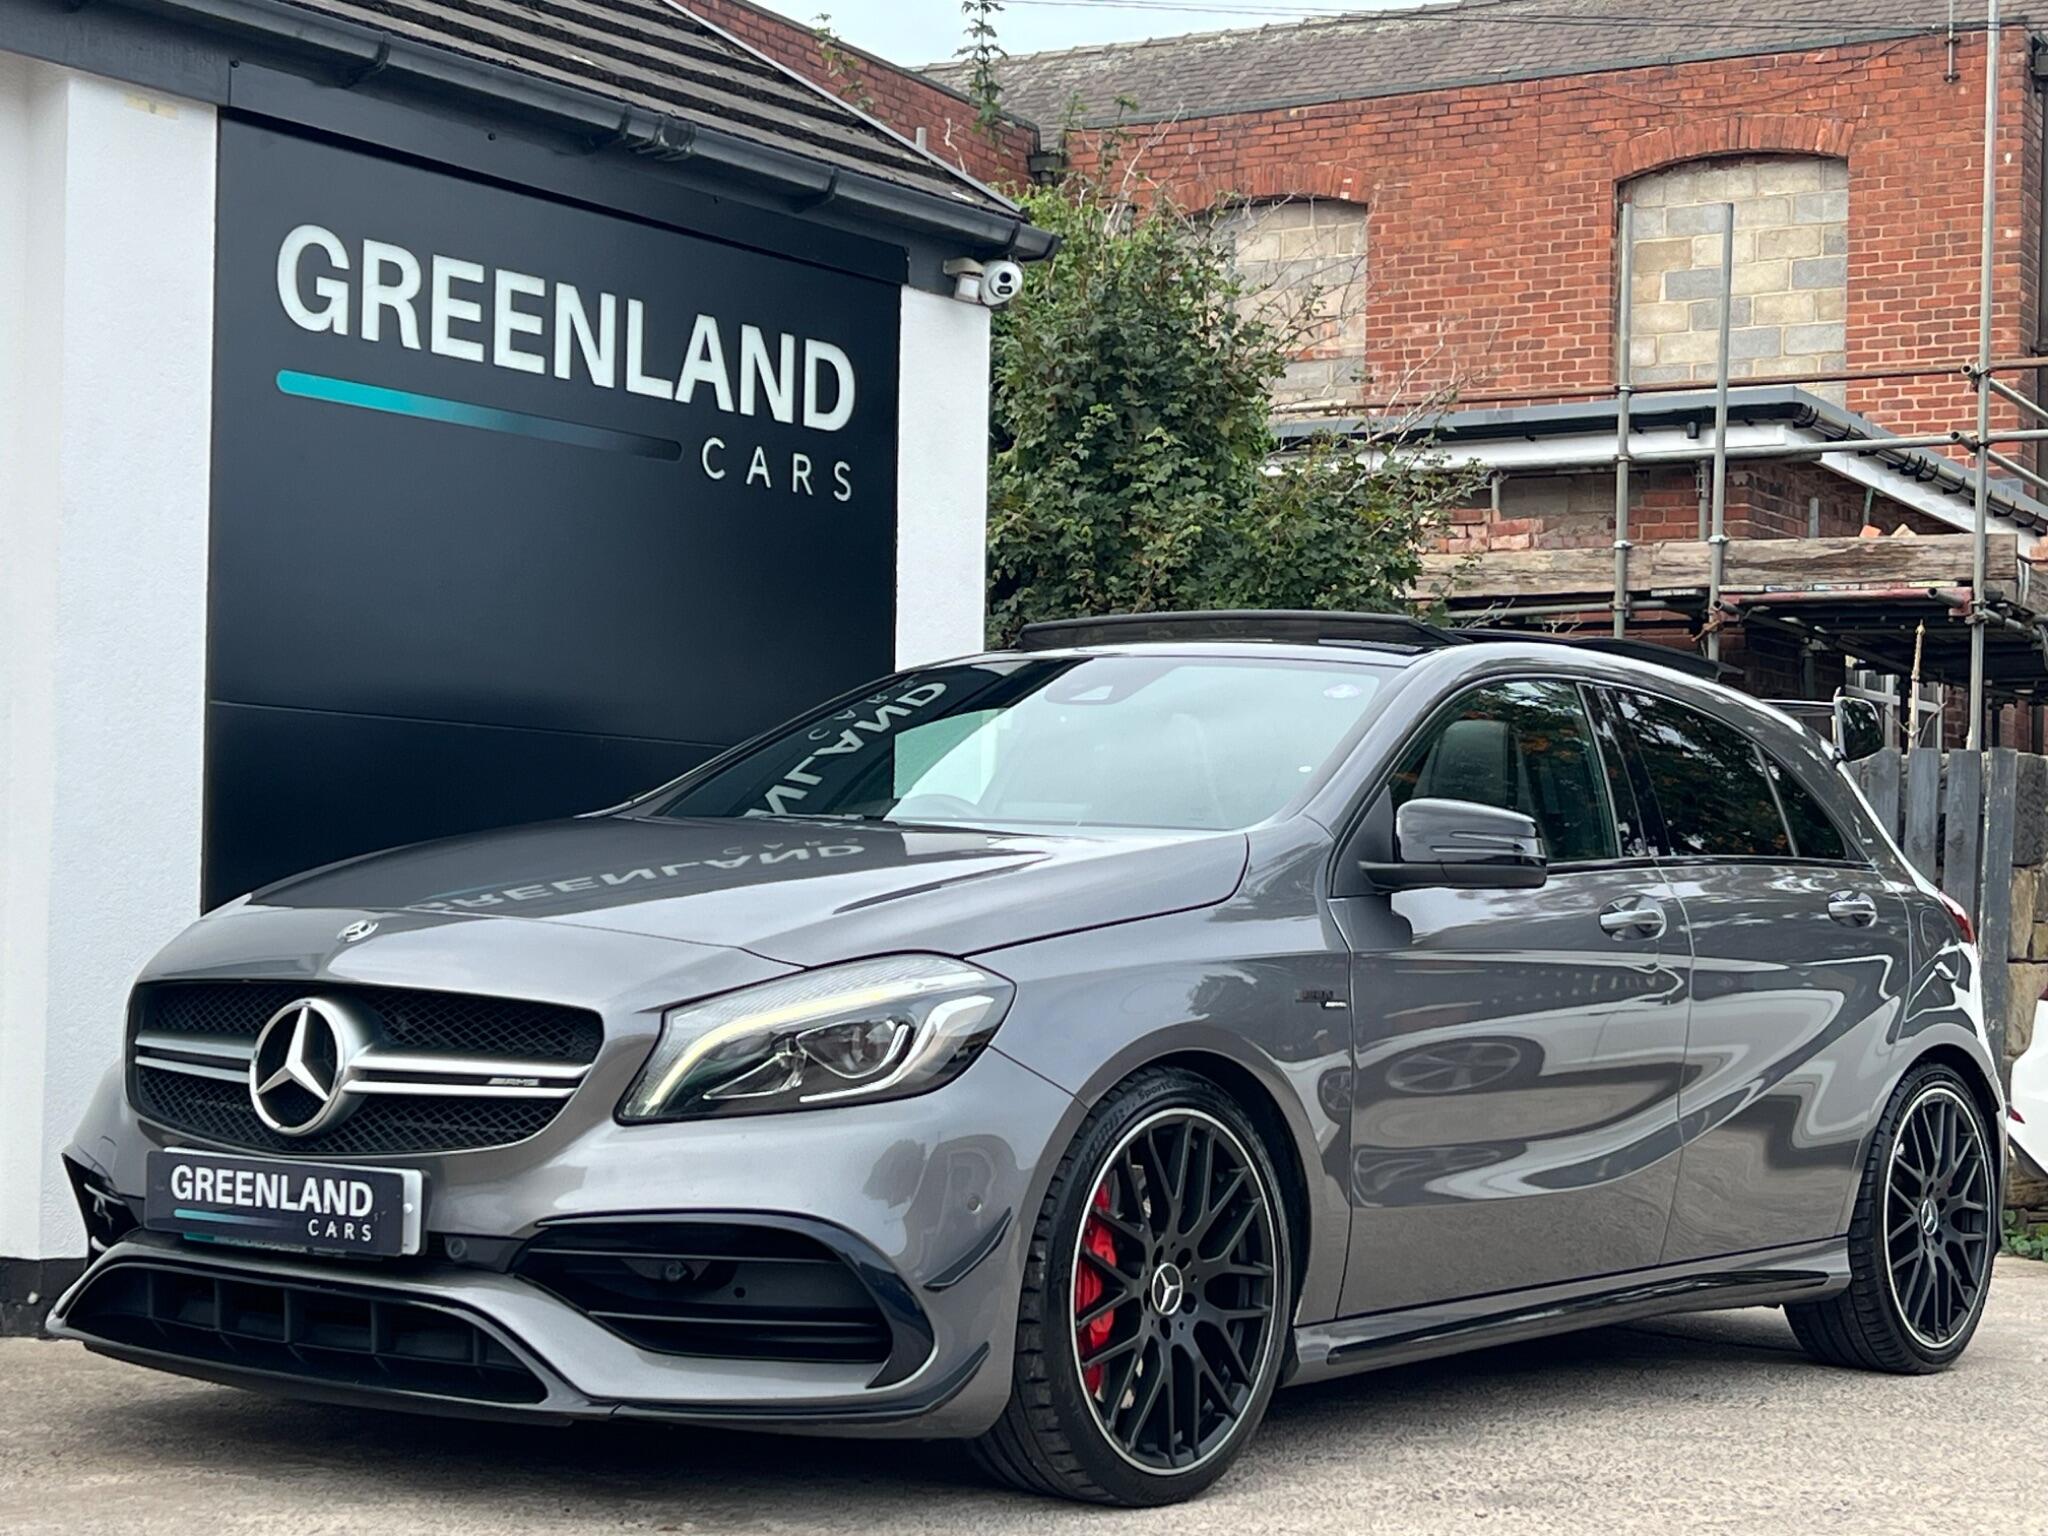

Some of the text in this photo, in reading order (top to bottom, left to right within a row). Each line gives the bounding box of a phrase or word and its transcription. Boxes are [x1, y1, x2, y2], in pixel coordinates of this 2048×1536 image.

[277, 224, 856, 432] GREENLAND
[701, 437, 852, 502] CARS
[171, 1165, 374, 1218] GREENLAND
[308, 1219, 372, 1242] CARS
